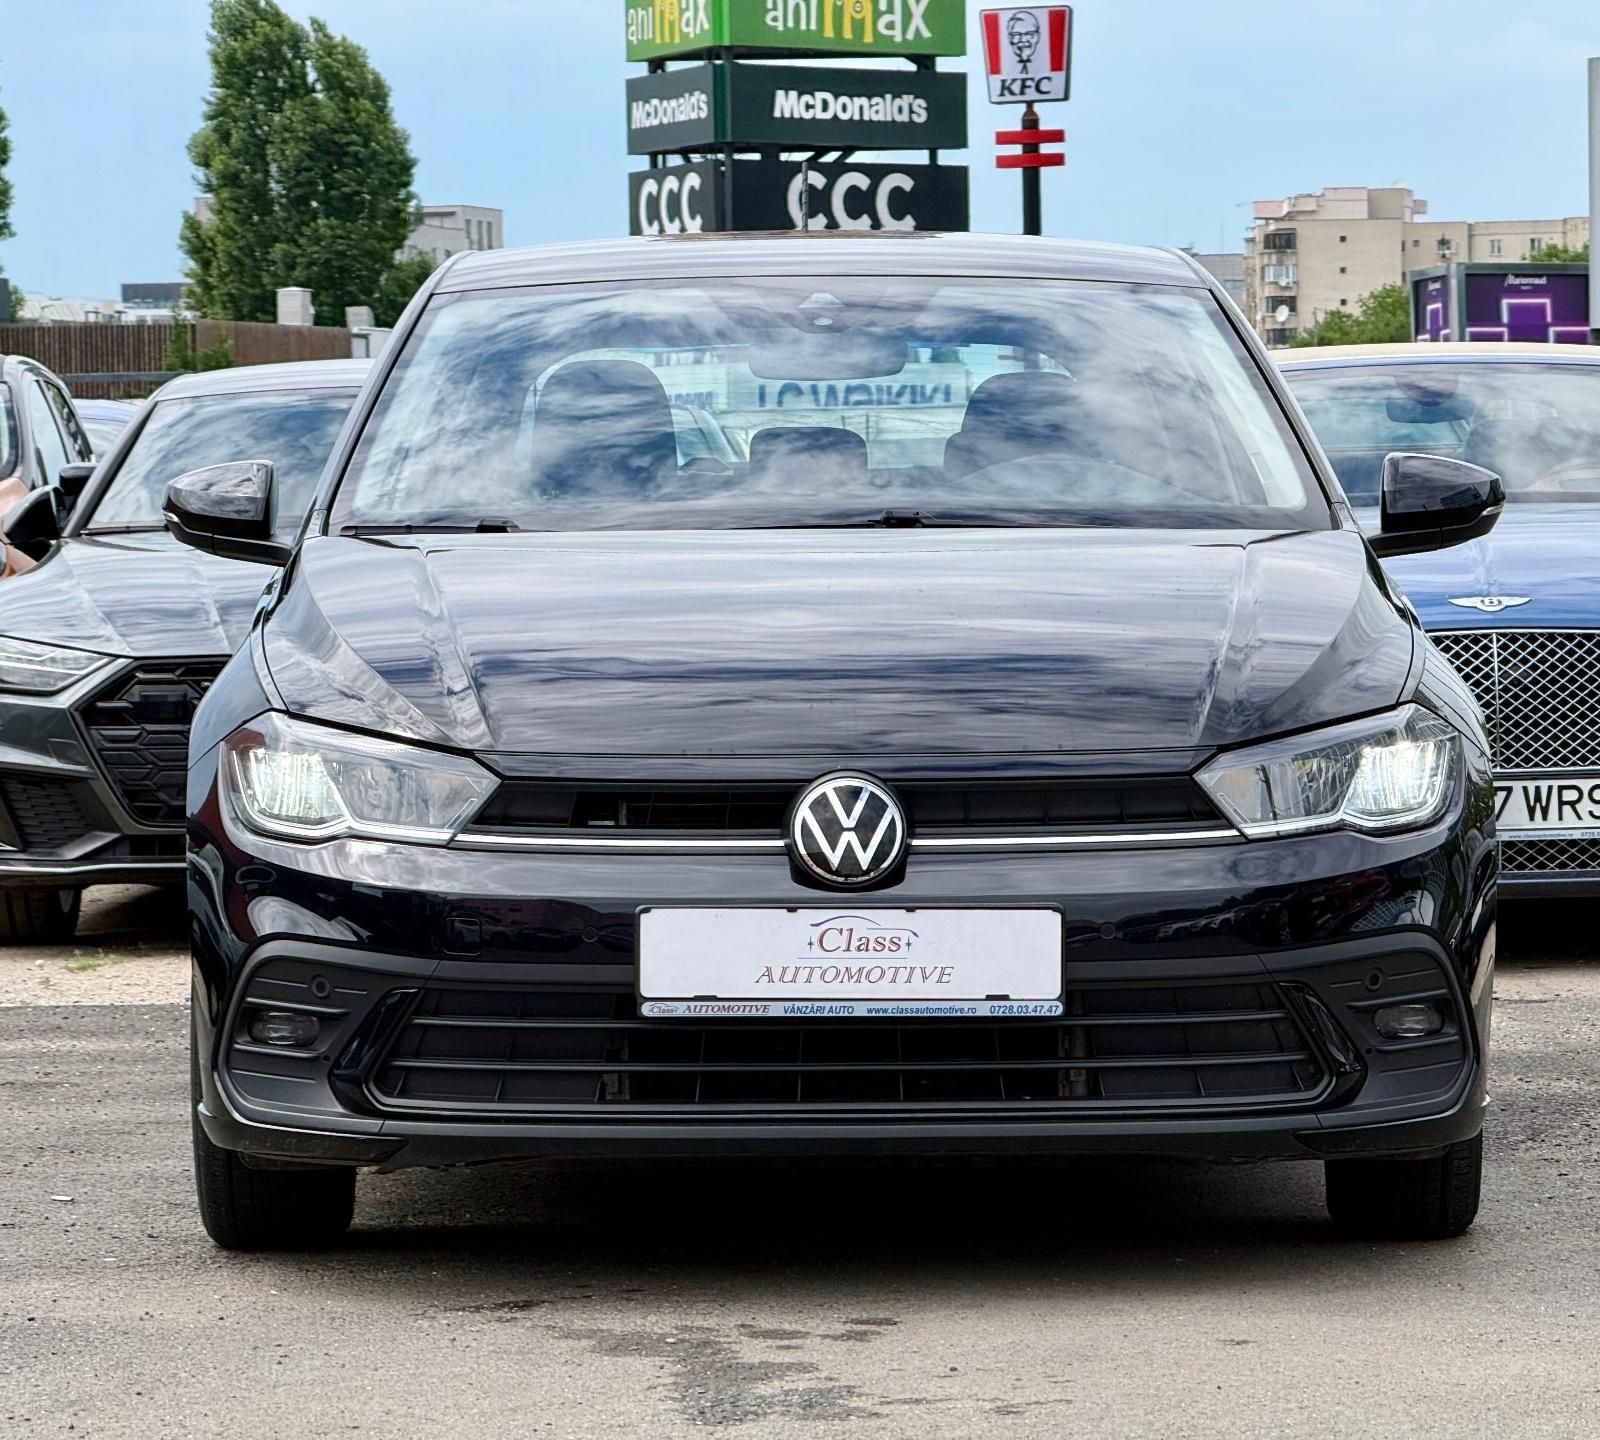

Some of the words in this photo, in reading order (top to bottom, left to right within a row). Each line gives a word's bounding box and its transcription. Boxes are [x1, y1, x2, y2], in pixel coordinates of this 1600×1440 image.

[999, 77, 1052, 96] KFC
[631, 91, 708, 129] McDonald's
[773, 90, 928, 123] McDonald's
[639, 172, 702, 233] CCC
[787, 170, 915, 231] CCC
[817, 927, 902, 952] Class
[754, 965, 955, 984] AUTOMOTIVE
[682, 1004, 770, 1014] AUTOMOTIVE
[827, 1006, 855, 1015] AUTO
[866, 1005, 977, 1015] www.classautomotive.ro
[989, 1004, 1059, 1015] 0728.03.47.47
